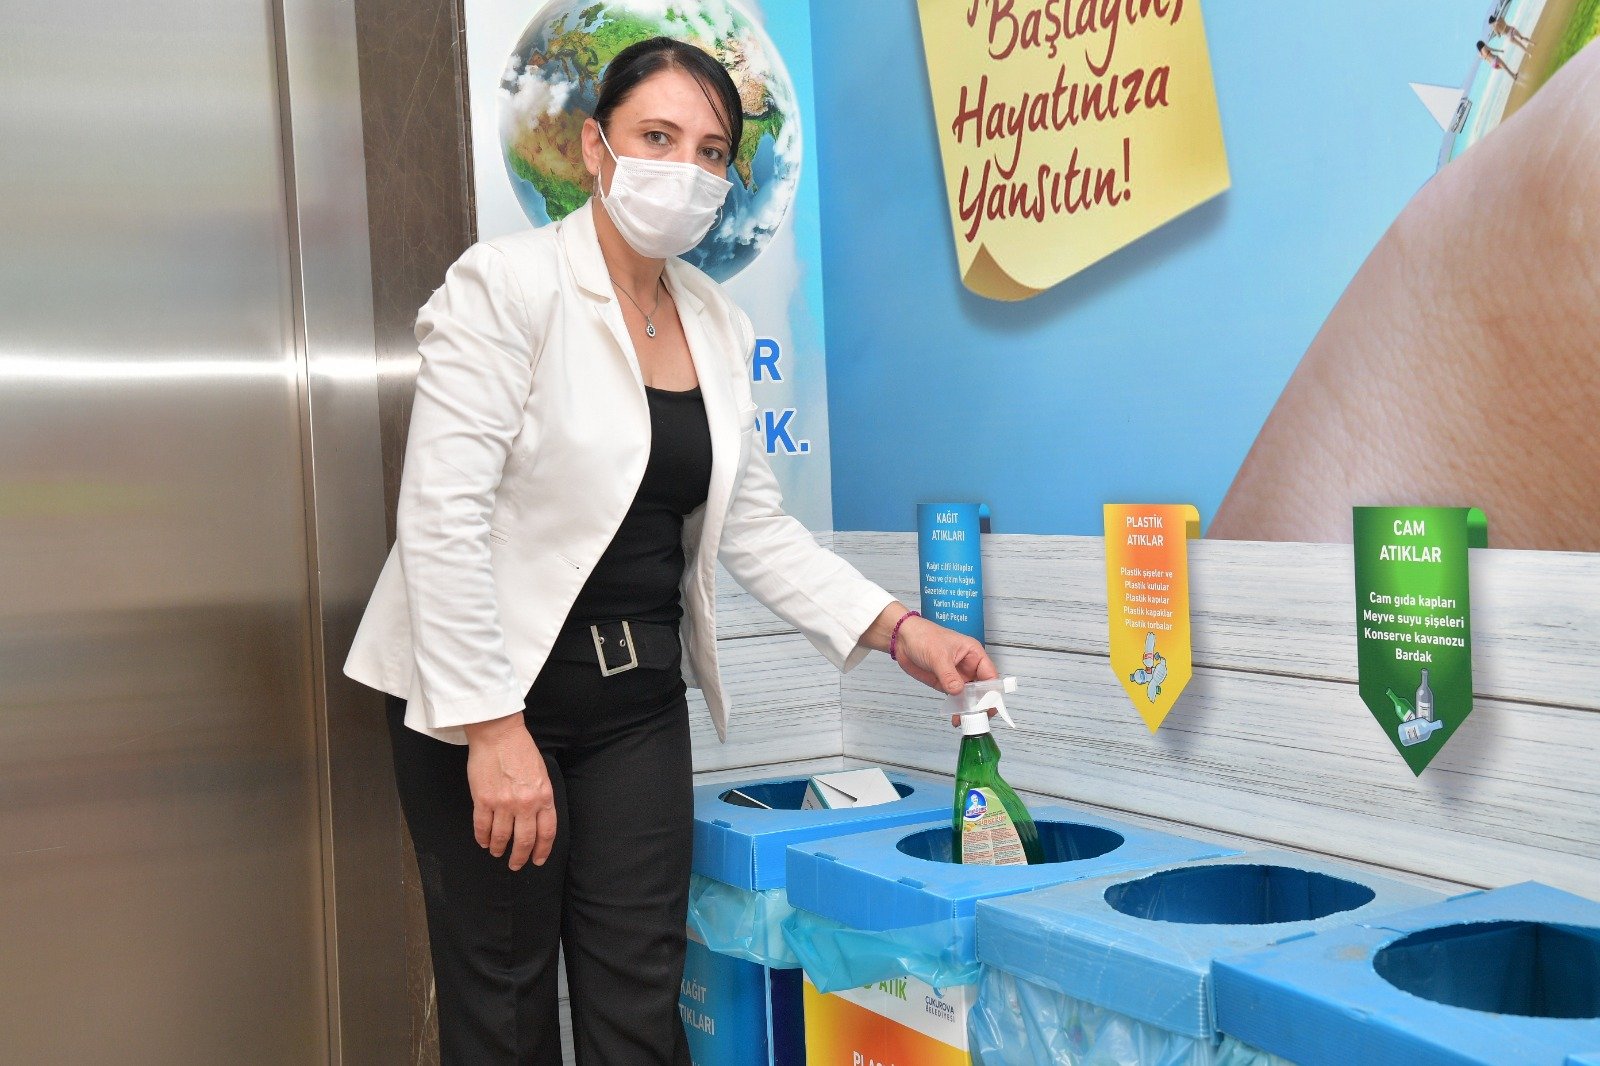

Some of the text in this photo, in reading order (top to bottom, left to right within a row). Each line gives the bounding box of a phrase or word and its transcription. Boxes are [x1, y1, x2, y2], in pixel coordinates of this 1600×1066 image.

[952, 64, 1170, 180] Hayatınıza
[958, 137, 1132, 243] Yansıtın!
[936, 510, 959, 524] KAĞIT
[1126, 514, 1163, 529] PLASTİK
[1393, 519, 1425, 537] CAM
[931, 530, 965, 542] ATIKLARI
[1127, 534, 1164, 547] ATIKLAR
[1379, 544, 1442, 563] ATIKLAR
[926, 561, 940, 572] Kağıt
[1120, 566, 1142, 576] Plastik
[1142, 568, 1163, 578] şişeler
[1124, 580, 1169, 591] Plastik kutular
[1125, 593, 1147, 602] Plastik
[1369, 591, 1456, 609] Cam gıda kapları
[935, 611, 949, 622] Kağıt
[1123, 606, 1172, 618] Plastik kapaklar
[1363, 609, 1464, 628] Meyve suyu şişeleri
[1125, 618, 1172, 630] Plastik torbalar
[1364, 627, 1465, 648] Konserve kavanozu
[1395, 647, 1432, 662] Bardak
[925, 995, 955, 1014] ÇUKUROVA
[678, 1002, 715, 1036] TIKLARI
